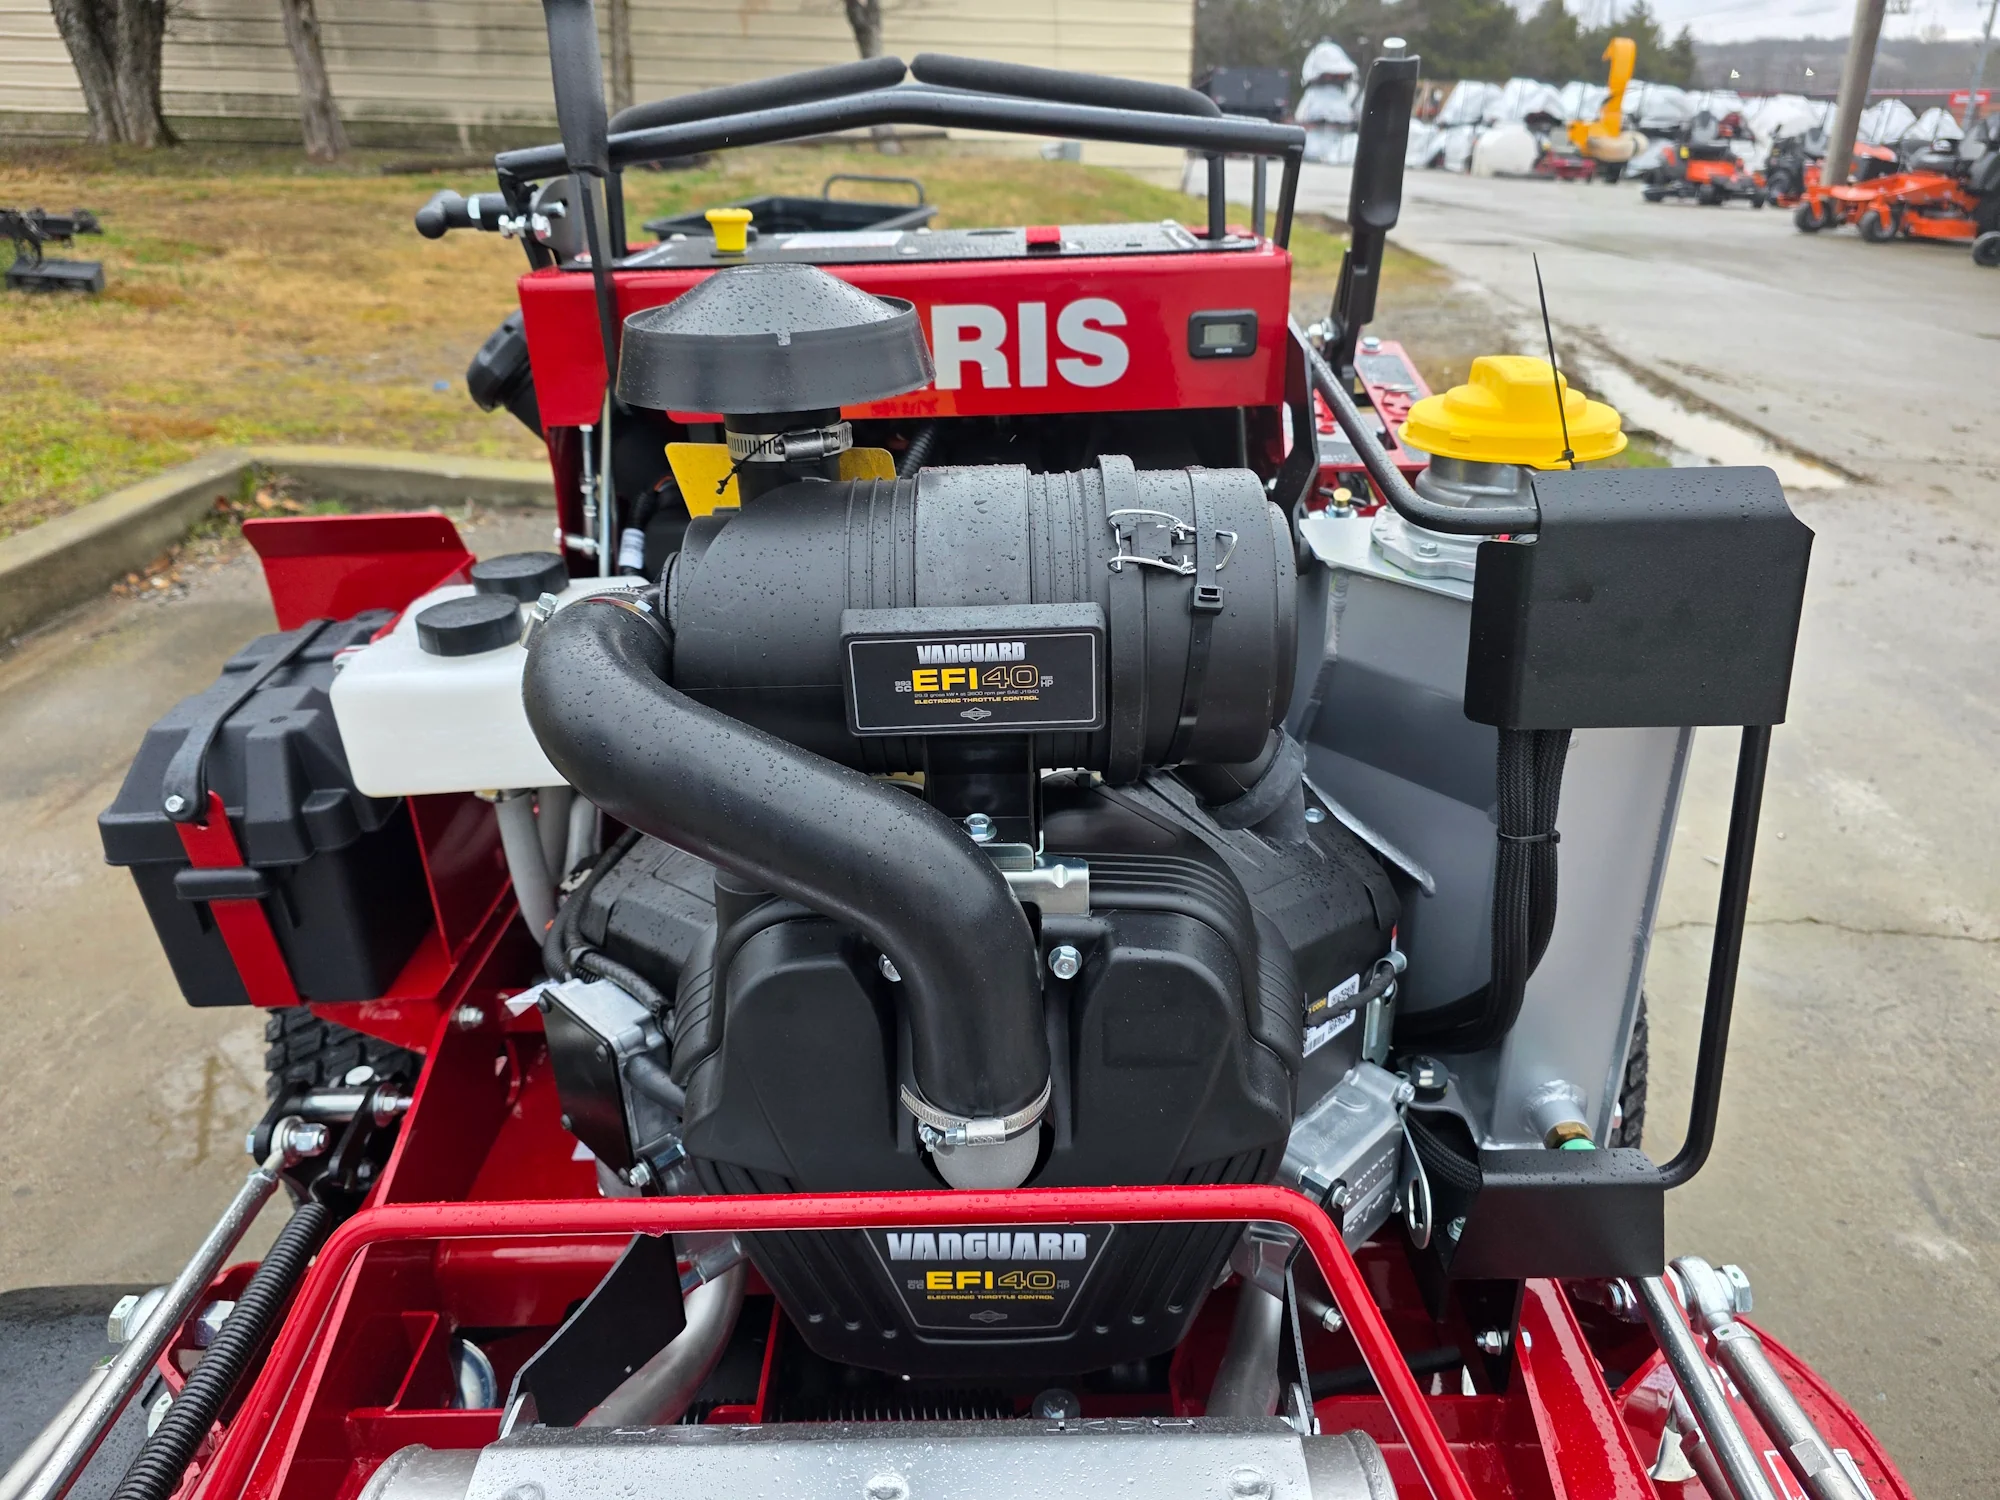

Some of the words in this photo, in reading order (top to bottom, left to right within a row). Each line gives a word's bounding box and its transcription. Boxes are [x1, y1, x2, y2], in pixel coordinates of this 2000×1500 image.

[930, 297, 1130, 390] RIS
[916, 642, 1025, 664] VANGUARD
[912, 668, 979, 692] EFI
[982, 665, 1038, 688] 40
[886, 1232, 1087, 1261] VANGUARD
[926, 1270, 994, 1290] EFI
[997, 1270, 1056, 1290] 40
